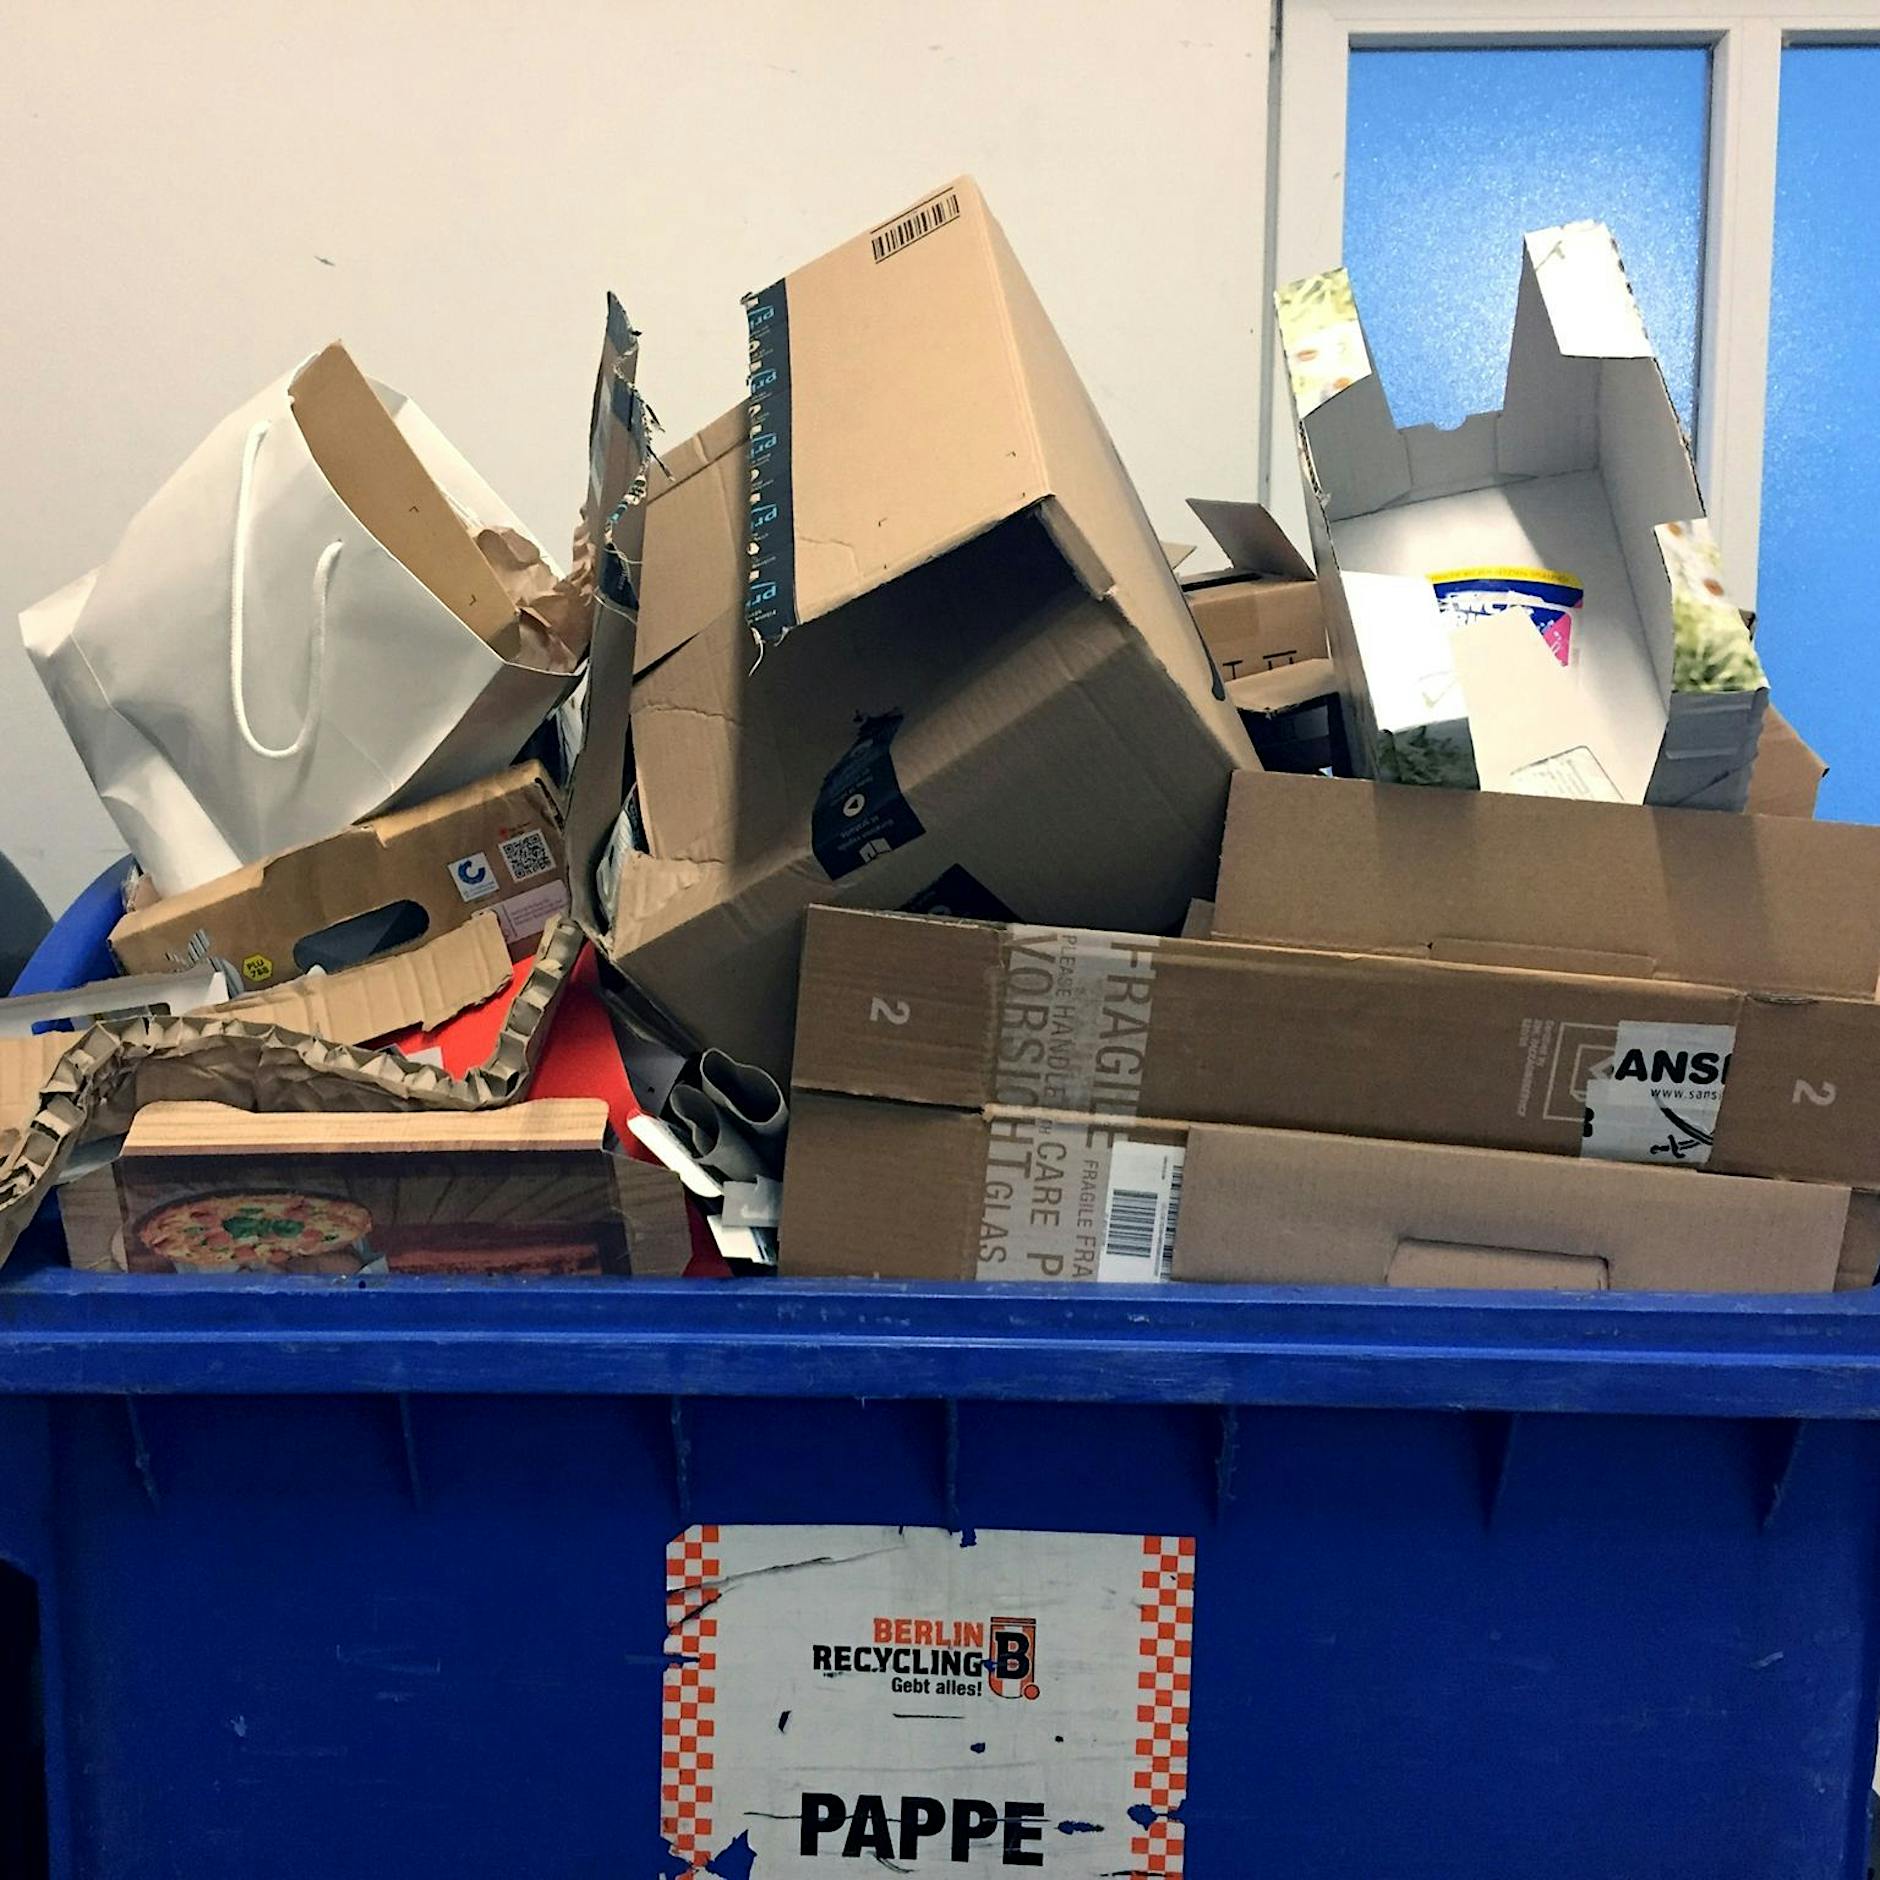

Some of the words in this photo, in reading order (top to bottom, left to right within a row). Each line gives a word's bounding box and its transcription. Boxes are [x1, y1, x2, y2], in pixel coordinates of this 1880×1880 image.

[246, 958, 265, 970] PLU
[1056, 935, 1077, 997] PLEASE
[869, 996, 910, 1026] 2
[1044, 1005, 1075, 1098] HANDLE
[1086, 941, 1160, 1149] FRAGILE
[1791, 1079, 1837, 1107] 2
[1030, 1142, 1067, 1227] CARE
[1077, 1159, 1099, 1228] FRAGILE
[978, 1181, 1013, 1263] GLAS
[1072, 1235, 1096, 1279] FRA
[873, 1617, 984, 1648] BERLIN
[813, 1644, 984, 1677] RECYCLING
[891, 1675, 931, 1695] Gebt
[935, 1678, 983, 1697] alles!
[800, 1792, 1045, 1867] PAPPE
